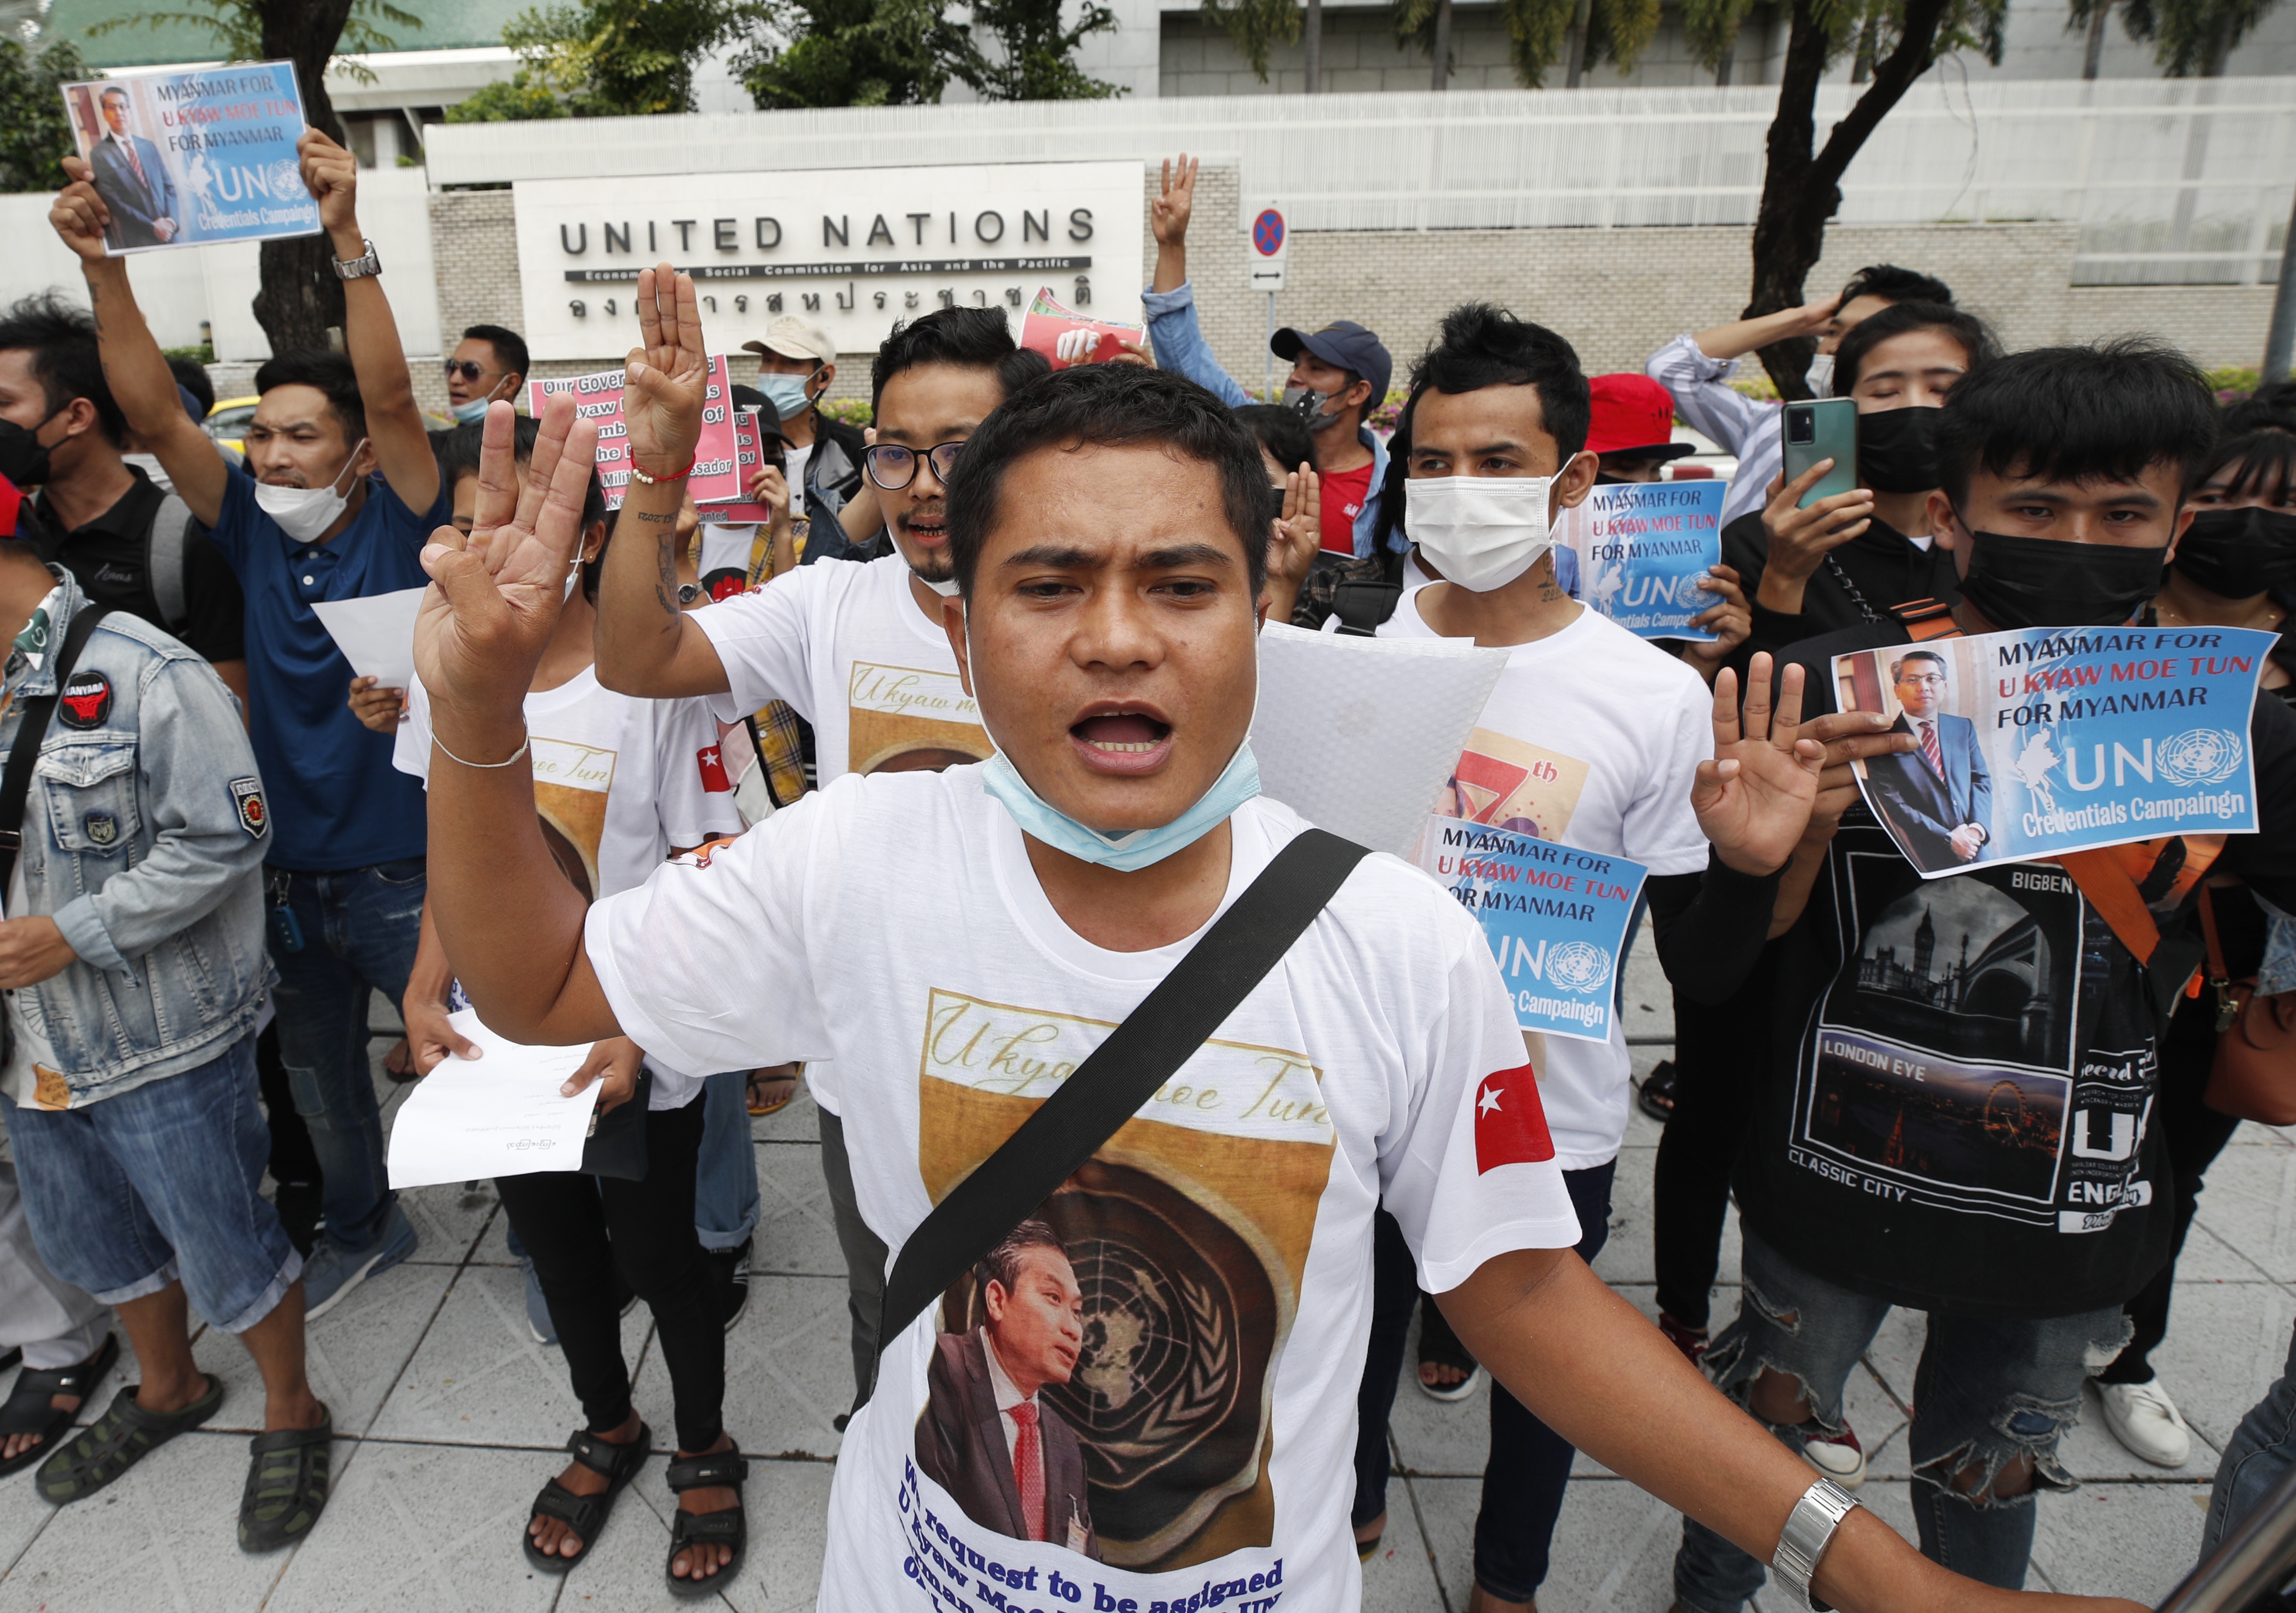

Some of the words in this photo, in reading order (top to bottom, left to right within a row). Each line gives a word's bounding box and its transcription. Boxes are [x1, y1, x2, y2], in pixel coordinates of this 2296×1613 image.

[157, 79, 238, 101] MYANMAR
[241, 76, 273, 93] FOR
[162, 111, 174, 126] U
[178, 107, 221, 125] KYAW
[225, 102, 262, 121] MOE
[264, 99, 296, 116] TUN
[168, 134, 202, 151] FOR
[204, 126, 284, 148] MYANMAR
[197, 209, 260, 230] Credentials
[560, 216, 783, 254] UNITED
[822, 208, 1094, 247] NATIONS
[585, 270, 638, 280] Econom
[705, 267, 750, 277] Social
[765, 264, 852, 276] Commission
[864, 263, 885, 273] for
[900, 262, 932, 272] Asia
[944, 261, 970, 271] and
[983, 260, 1006, 270] the
[1018, 258, 1070, 268] Pacific
[576, 402, 616, 417] yaw
[705, 407, 724, 422] Of
[597, 447, 620, 460] he
[739, 435, 751, 445] Is
[739, 453, 755, 463] Of
[700, 511, 728, 521] anted
[1594, 492, 1666, 511] MYANMAR
[1671, 490, 1701, 506] FOR
[1594, 520, 1603, 536] U
[1608, 518, 1649, 535] KYAW
[1652, 515, 1683, 532] MOE
[1687, 514, 1717, 530] TUN
[1592, 544, 1624, 561] FOR
[1629, 540, 1703, 559] MYANMAR
[1999, 634, 2147, 667] MYANMAR
[2155, 634, 2222, 649] FOR
[1999, 677, 2015, 698] U
[2024, 665, 2104, 694] KYAW
[2111, 659, 2180, 683] MOE
[2187, 656, 2253, 675] TUN
[1998, 703, 2053, 728] FOR
[2060, 686, 2208, 721] MYANMAR
[532, 760, 557, 773] oe
[564, 748, 608, 782] Tun
[2066, 738, 2154, 792] UN
[2023, 801, 2127, 838] Credentials
[2130, 790, 2245, 821] Campaingn
[1443, 828, 1557, 863] MYANMAR
[1563, 851, 1611, 874] FOR
[1438, 856, 1453, 874] U
[1458, 858, 1523, 883] KYAW
[1525, 868, 1578, 893] MOE
[1585, 879, 1631, 902] TUN
[2012, 871, 2073, 894] BIGBEN
[1444, 885, 1478, 907] OR
[1482, 891, 1595, 922] MYANMAR
[1518, 990, 1604, 1027] Campaingn
[1824, 1040, 1889, 1071] LONDON
[1892, 1059, 1927, 1083] EYE
[1155, 1084, 1221, 1109] oe
[1238, 1057, 1332, 1125] Tun
[1788, 1149, 1858, 1188] CLASSIC
[1863, 1178, 1907, 1202] CITY
[899, 1480, 910, 1514] U
[912, 1508, 969, 1587] Kyaw
[905, 1453, 921, 1511] We
[925, 1507, 1039, 1591] request
[1048, 1570, 1081, 1603] to
[1093, 1583, 1138, 1613] be
[1149, 1558, 1283, 1613] assigned
